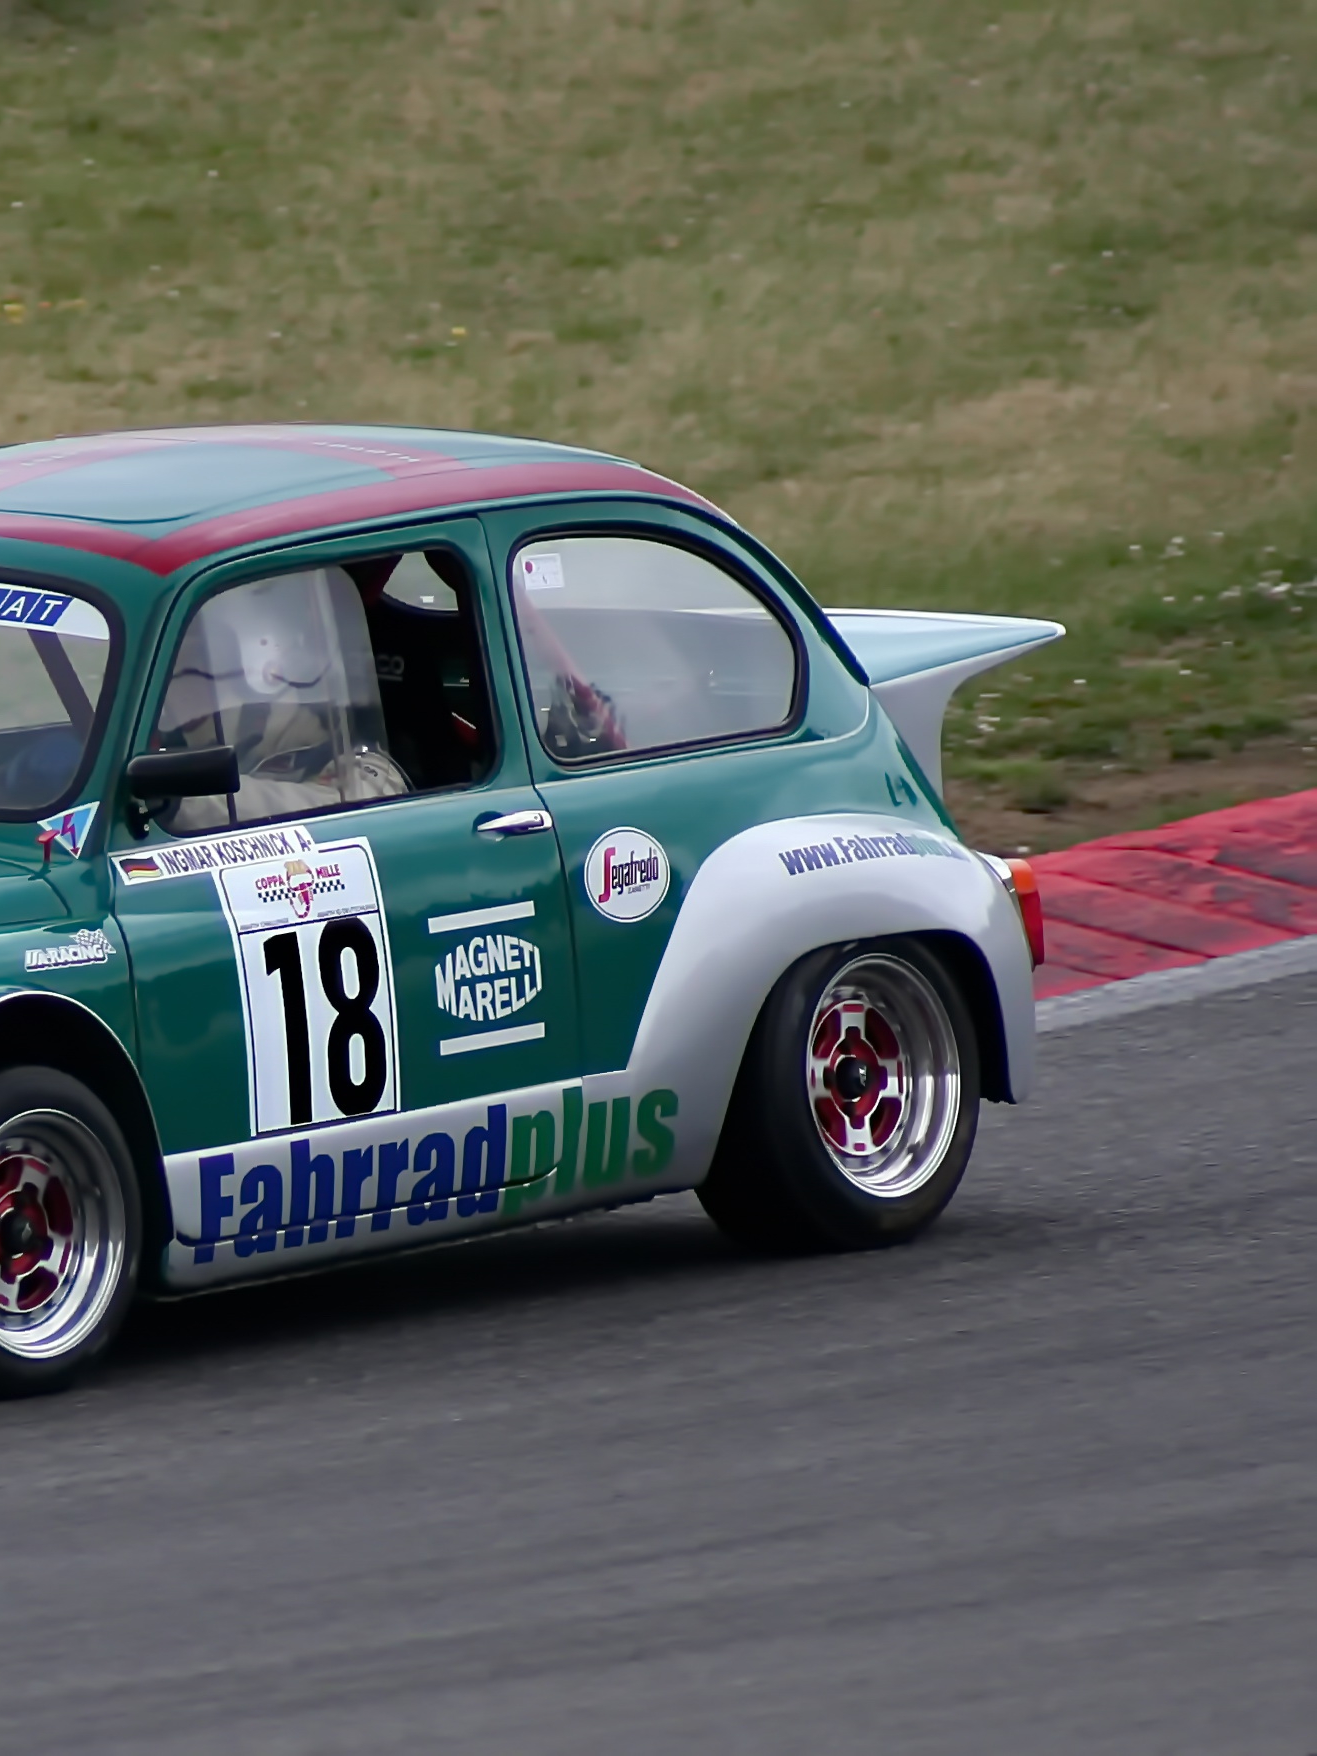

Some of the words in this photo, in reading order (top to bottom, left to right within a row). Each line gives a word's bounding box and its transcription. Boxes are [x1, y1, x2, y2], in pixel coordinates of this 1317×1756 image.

[158, 845, 219, 875] INGMAR
[212, 831, 295, 866] KOSCHNICK
[255, 874, 286, 891] COPPA
[315, 863, 342, 880] MILLE
[598, 846, 660, 904] Segafredo
[262, 915, 388, 1127] 18
[193, 1086, 679, 1264] Fahrradplus
